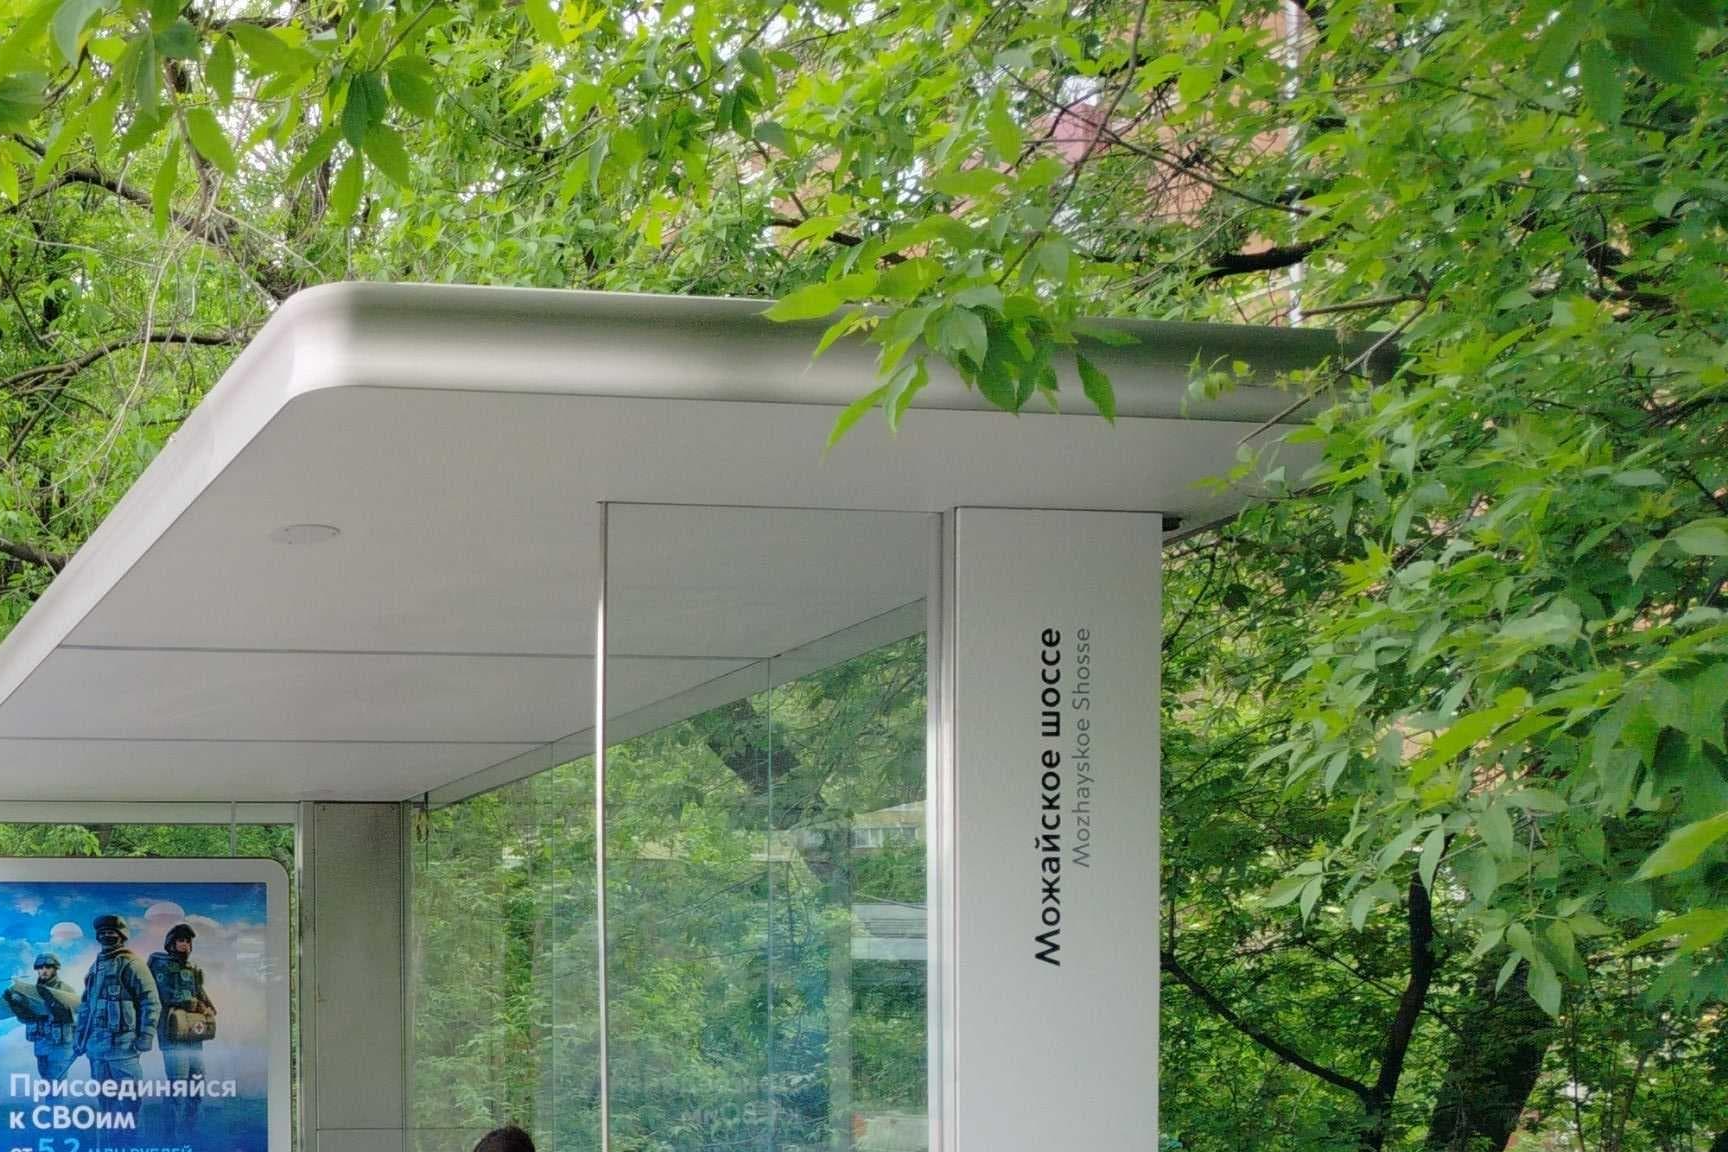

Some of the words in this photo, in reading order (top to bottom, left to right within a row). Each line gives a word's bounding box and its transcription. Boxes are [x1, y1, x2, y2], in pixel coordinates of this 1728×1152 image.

[1041, 627, 1061, 737] шоссе
[1072, 627, 1091, 711] Shosse
[1072, 717, 1095, 868] Mozhayskoe
[1035, 749, 1061, 967] Можайское
[9, 1111, 26, 1130] к
[32, 1104, 136, 1130] СВОим
[10, 1072, 237, 1102] Присоединяйся
